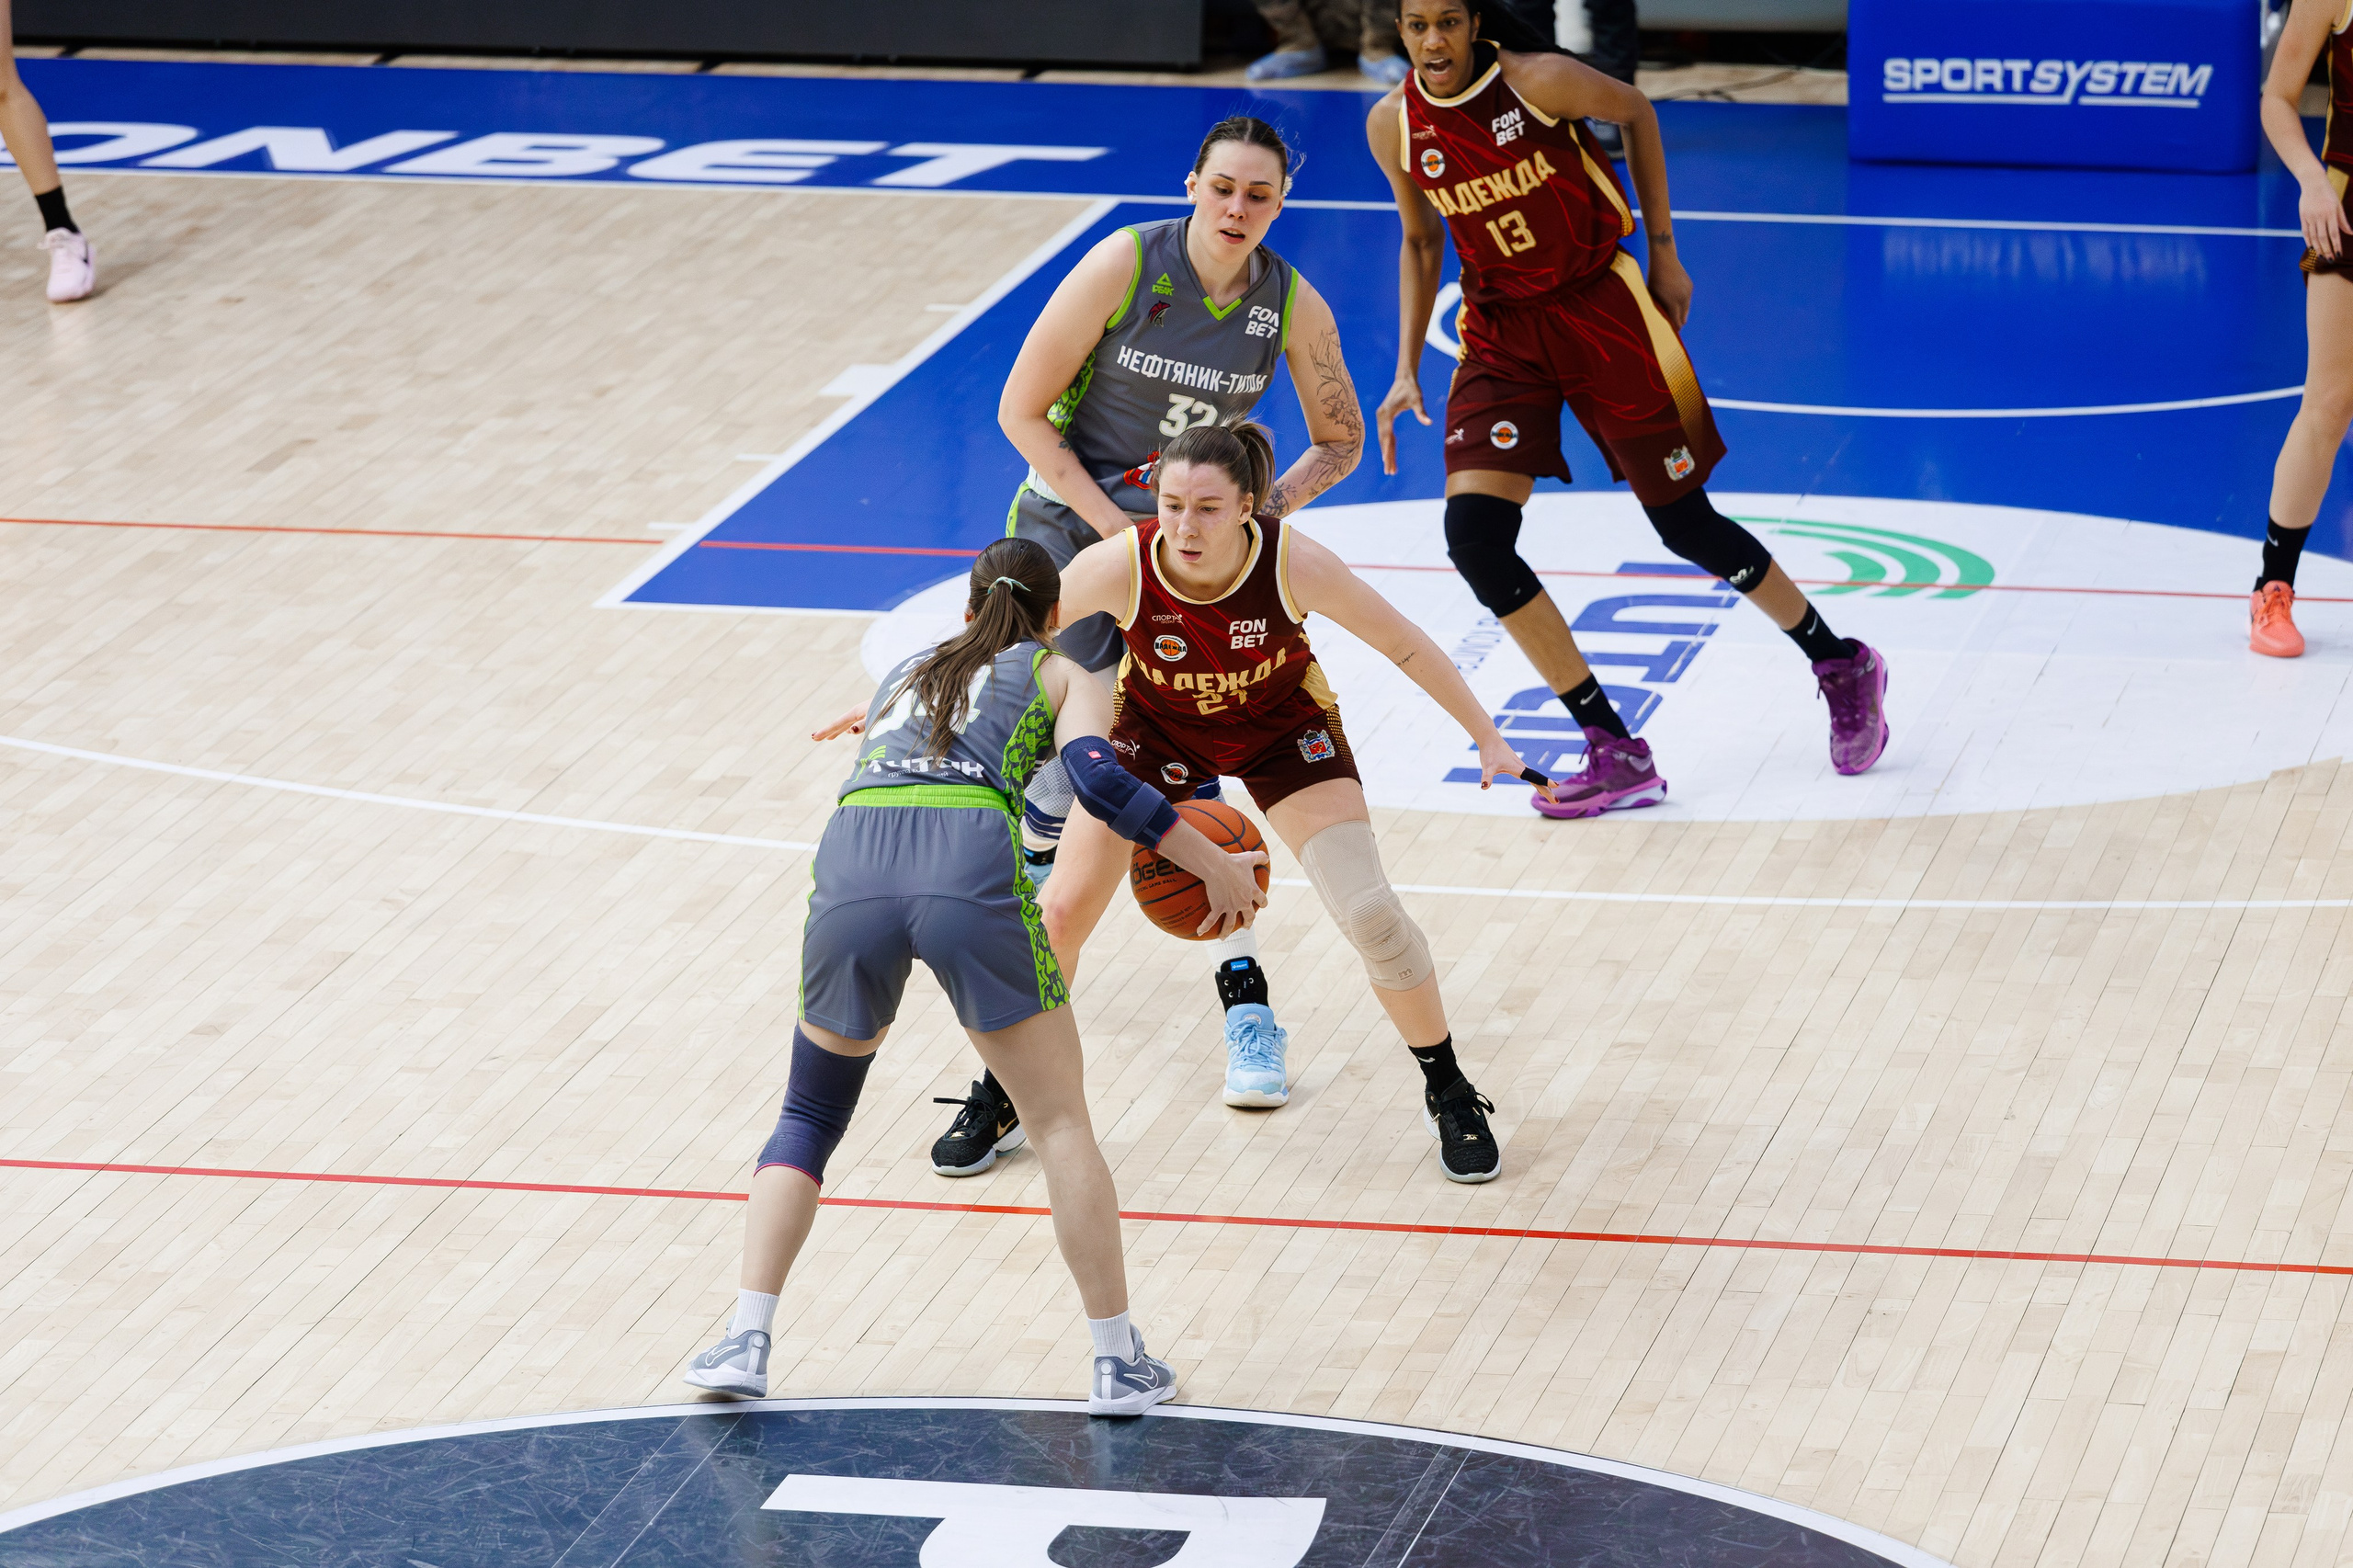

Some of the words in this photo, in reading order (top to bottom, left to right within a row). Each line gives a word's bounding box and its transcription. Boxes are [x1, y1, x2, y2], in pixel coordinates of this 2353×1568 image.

[1883, 58, 2213, 107] SPORTSYSTEM
[1492, 108, 1521, 133] FON
[1496, 120, 1526, 147] BET
[1424, 150, 1557, 218] НАДЕЖДА
[1485, 210, 1537, 257] 13
[1152, 284, 1176, 297] PEAK
[1245, 320, 1279, 339] BET
[1117, 344, 1267, 394] НЕФТЯНИК-ТИТАН
[1158, 392, 1218, 438] 32
[1229, 618, 1267, 635] FON
[1230, 631, 1268, 650] BET
